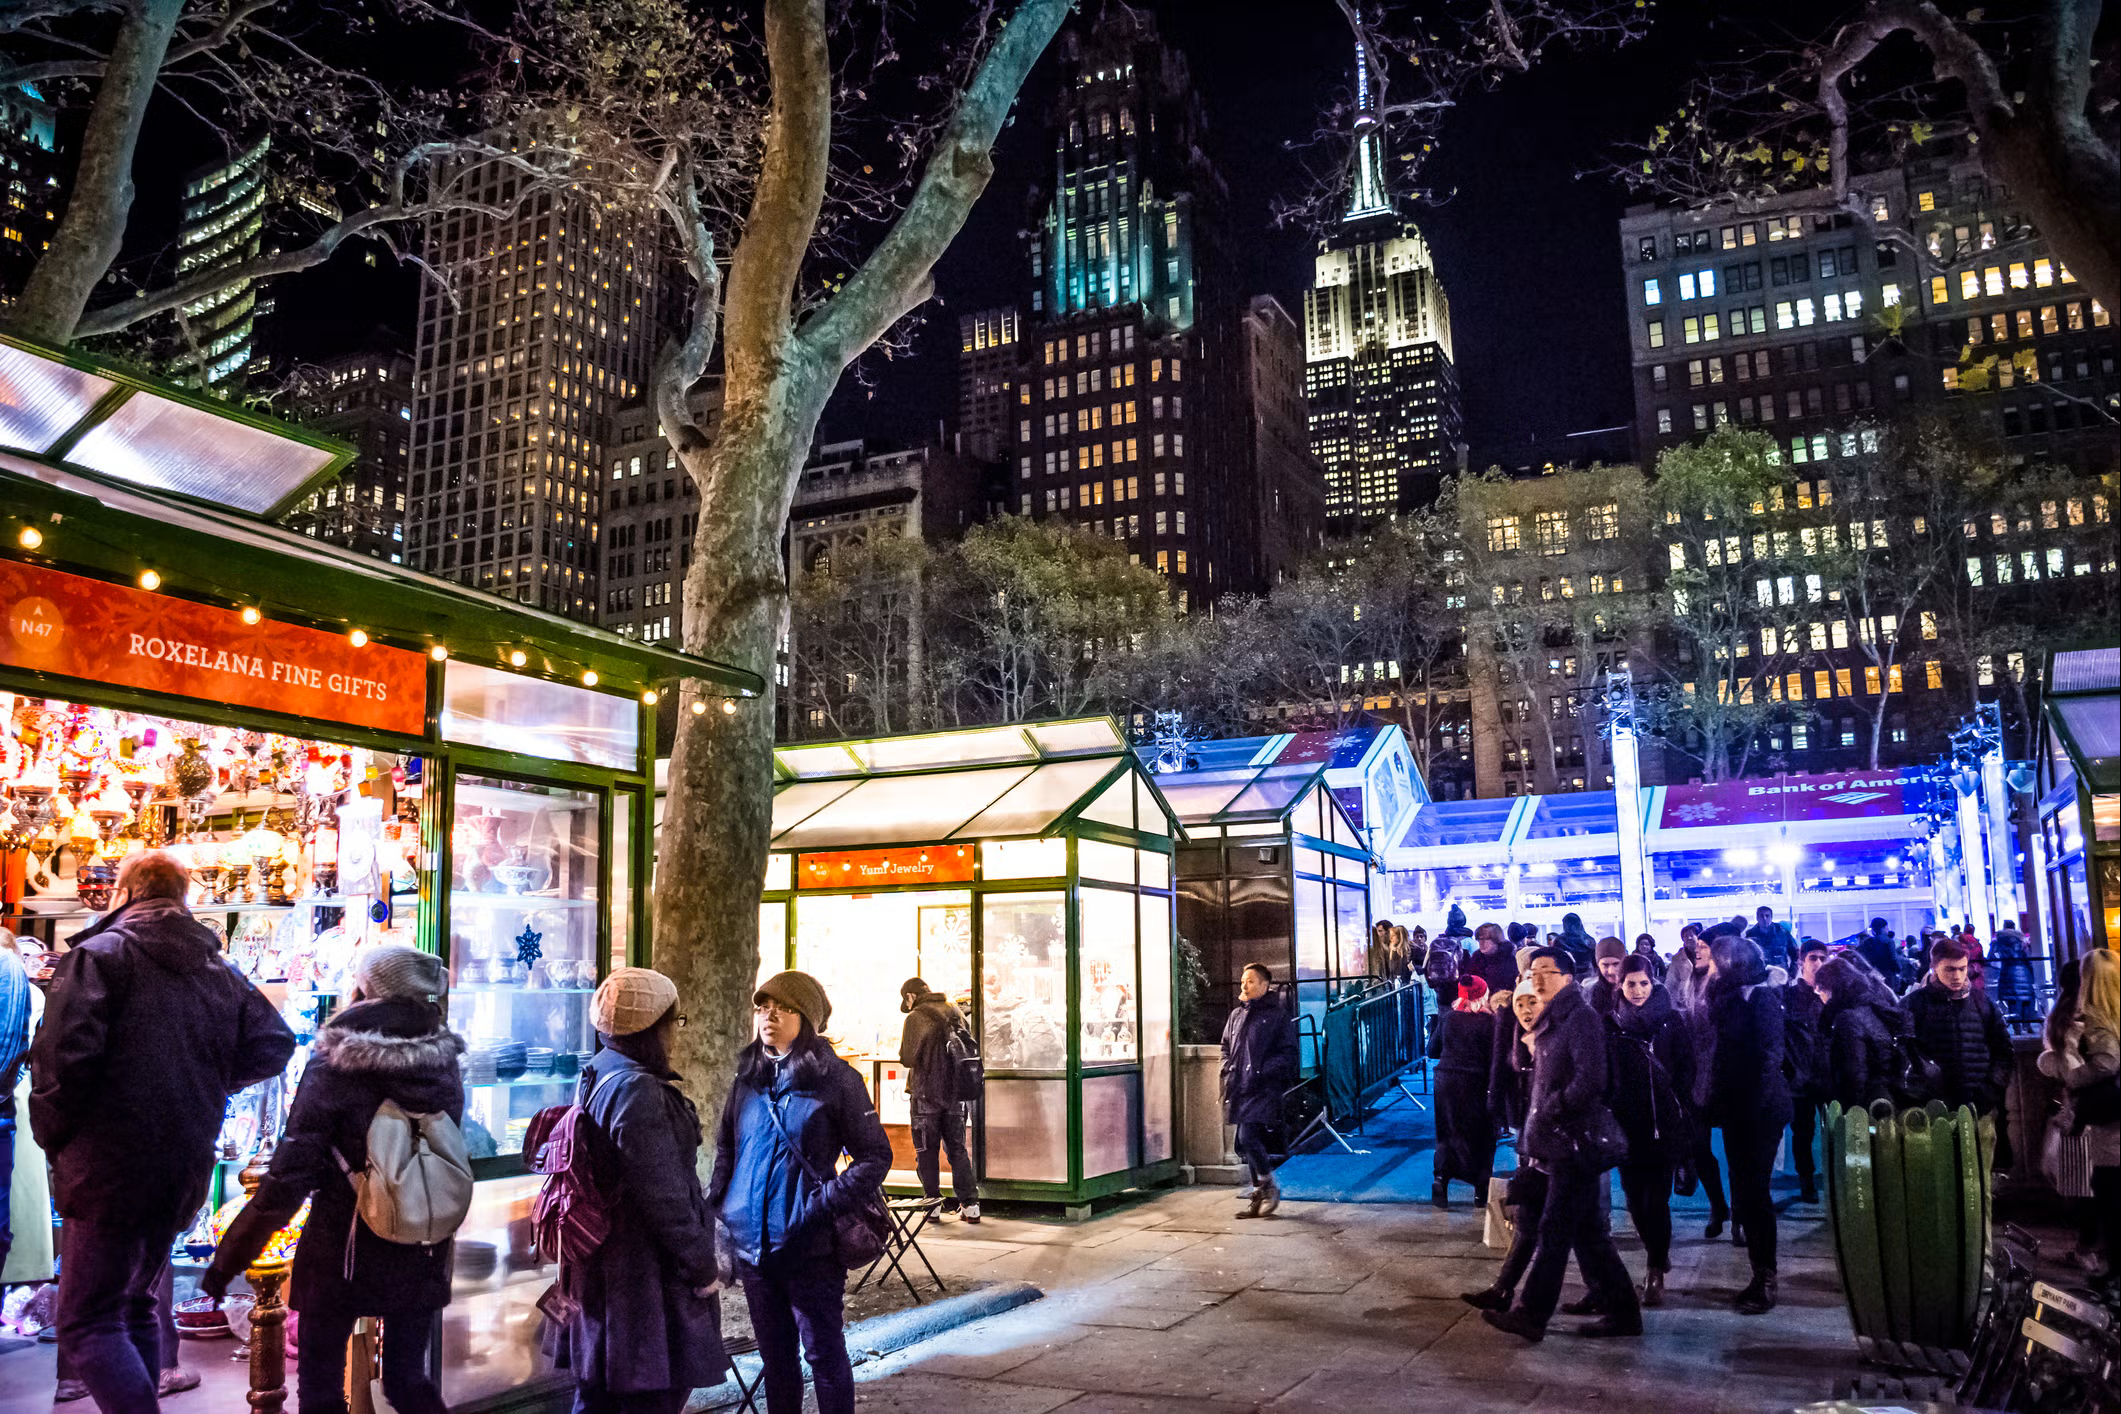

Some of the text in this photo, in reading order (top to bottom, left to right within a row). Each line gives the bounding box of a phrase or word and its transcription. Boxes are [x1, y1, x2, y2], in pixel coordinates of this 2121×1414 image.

[21, 619, 53, 637] N47
[129, 633, 387, 702] ROXELANA FINE GIFTS
[1748, 773, 1948, 796] Bank of Americ
[890, 861, 934, 875] Jewelry
[889, 1085, 911, 1101] YU
[2041, 1289, 2077, 1311] BRYANT PARK
